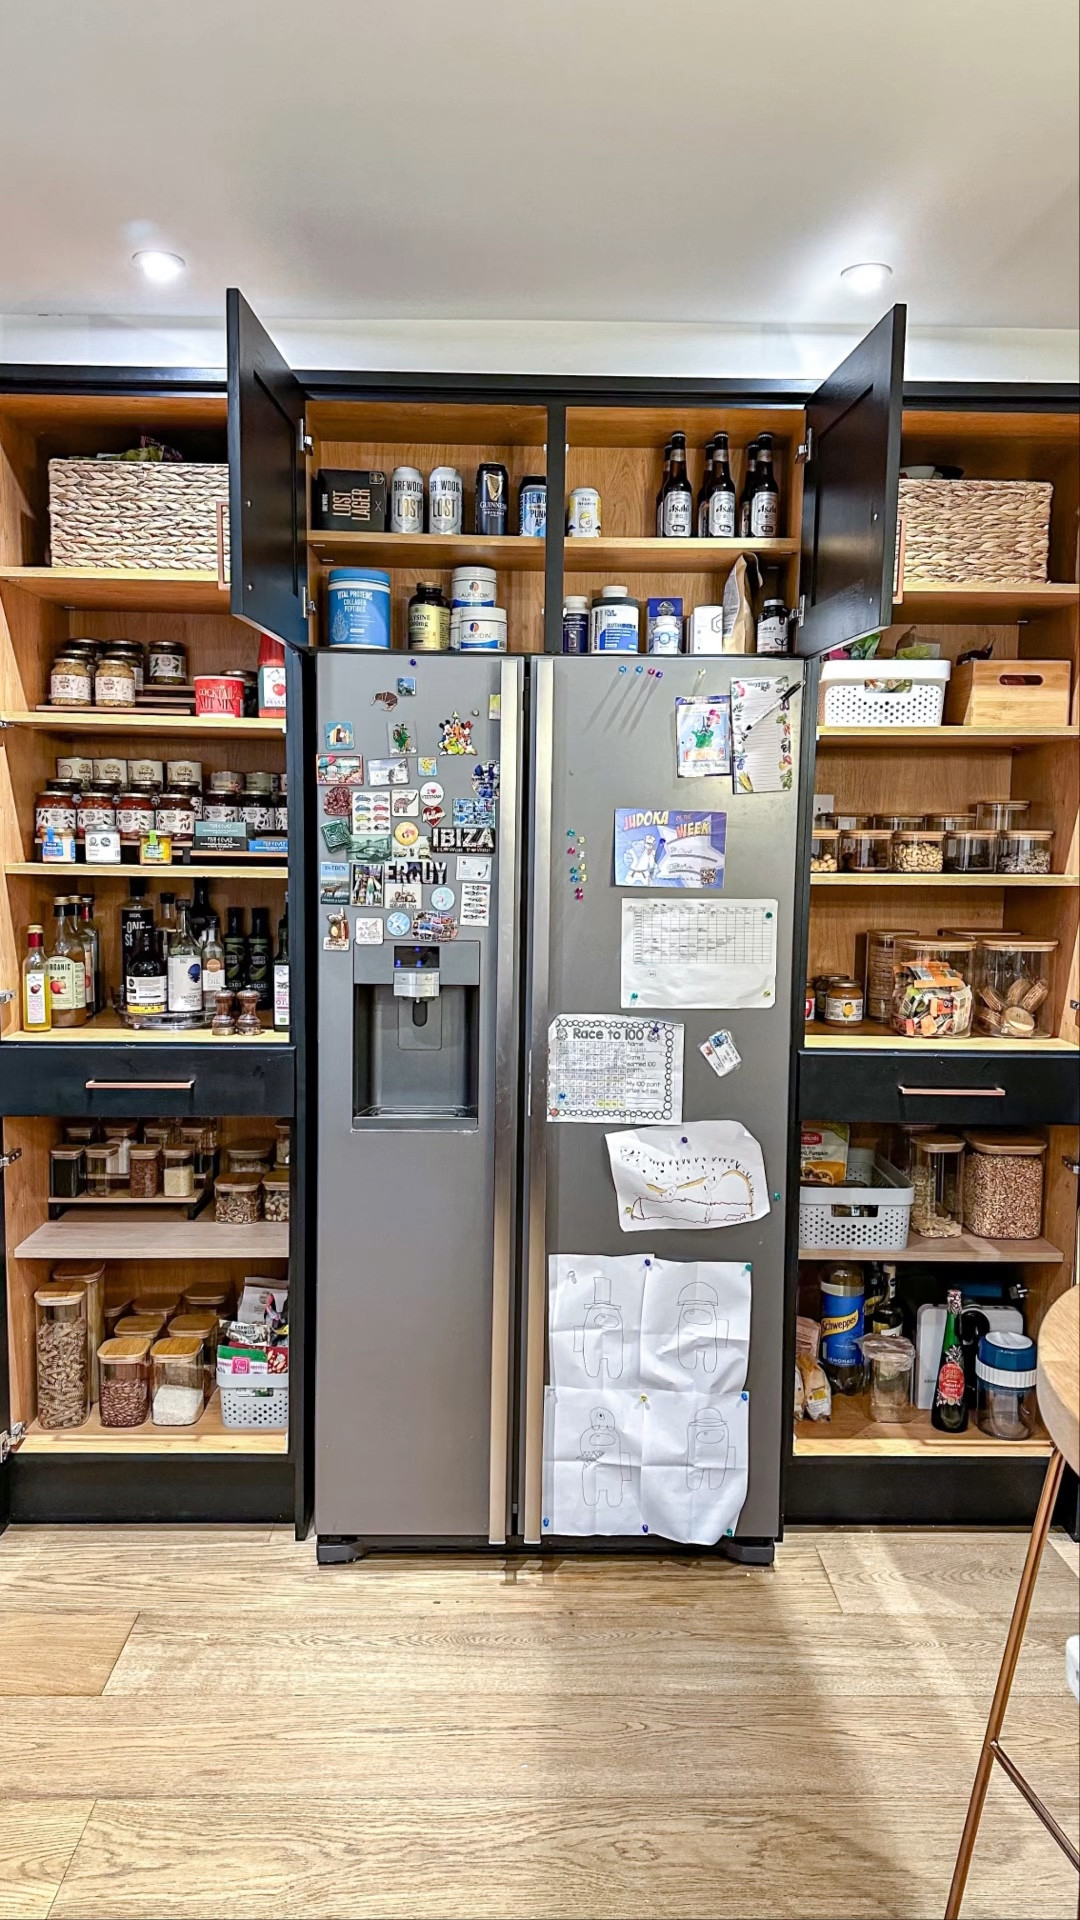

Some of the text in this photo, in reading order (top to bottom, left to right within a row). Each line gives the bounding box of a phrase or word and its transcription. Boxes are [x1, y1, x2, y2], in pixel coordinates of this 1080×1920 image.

[430, 480, 461, 493] BRWDOG
[333, 490, 352, 516] LOST
[351, 488, 371, 521] LAGER
[397, 498, 423, 518] LOST
[432, 498, 456, 518] LOST
[198, 684, 234, 700] COCKTAIL
[199, 697, 235, 711] NUT MIX
[624, 811, 669, 831] JUDOKA
[676, 821, 712, 839] WEEK
[432, 828, 495, 848] IBIZA
[572, 1027, 645, 1041] Race to 100
[823, 1315, 857, 1332] Schweppes
